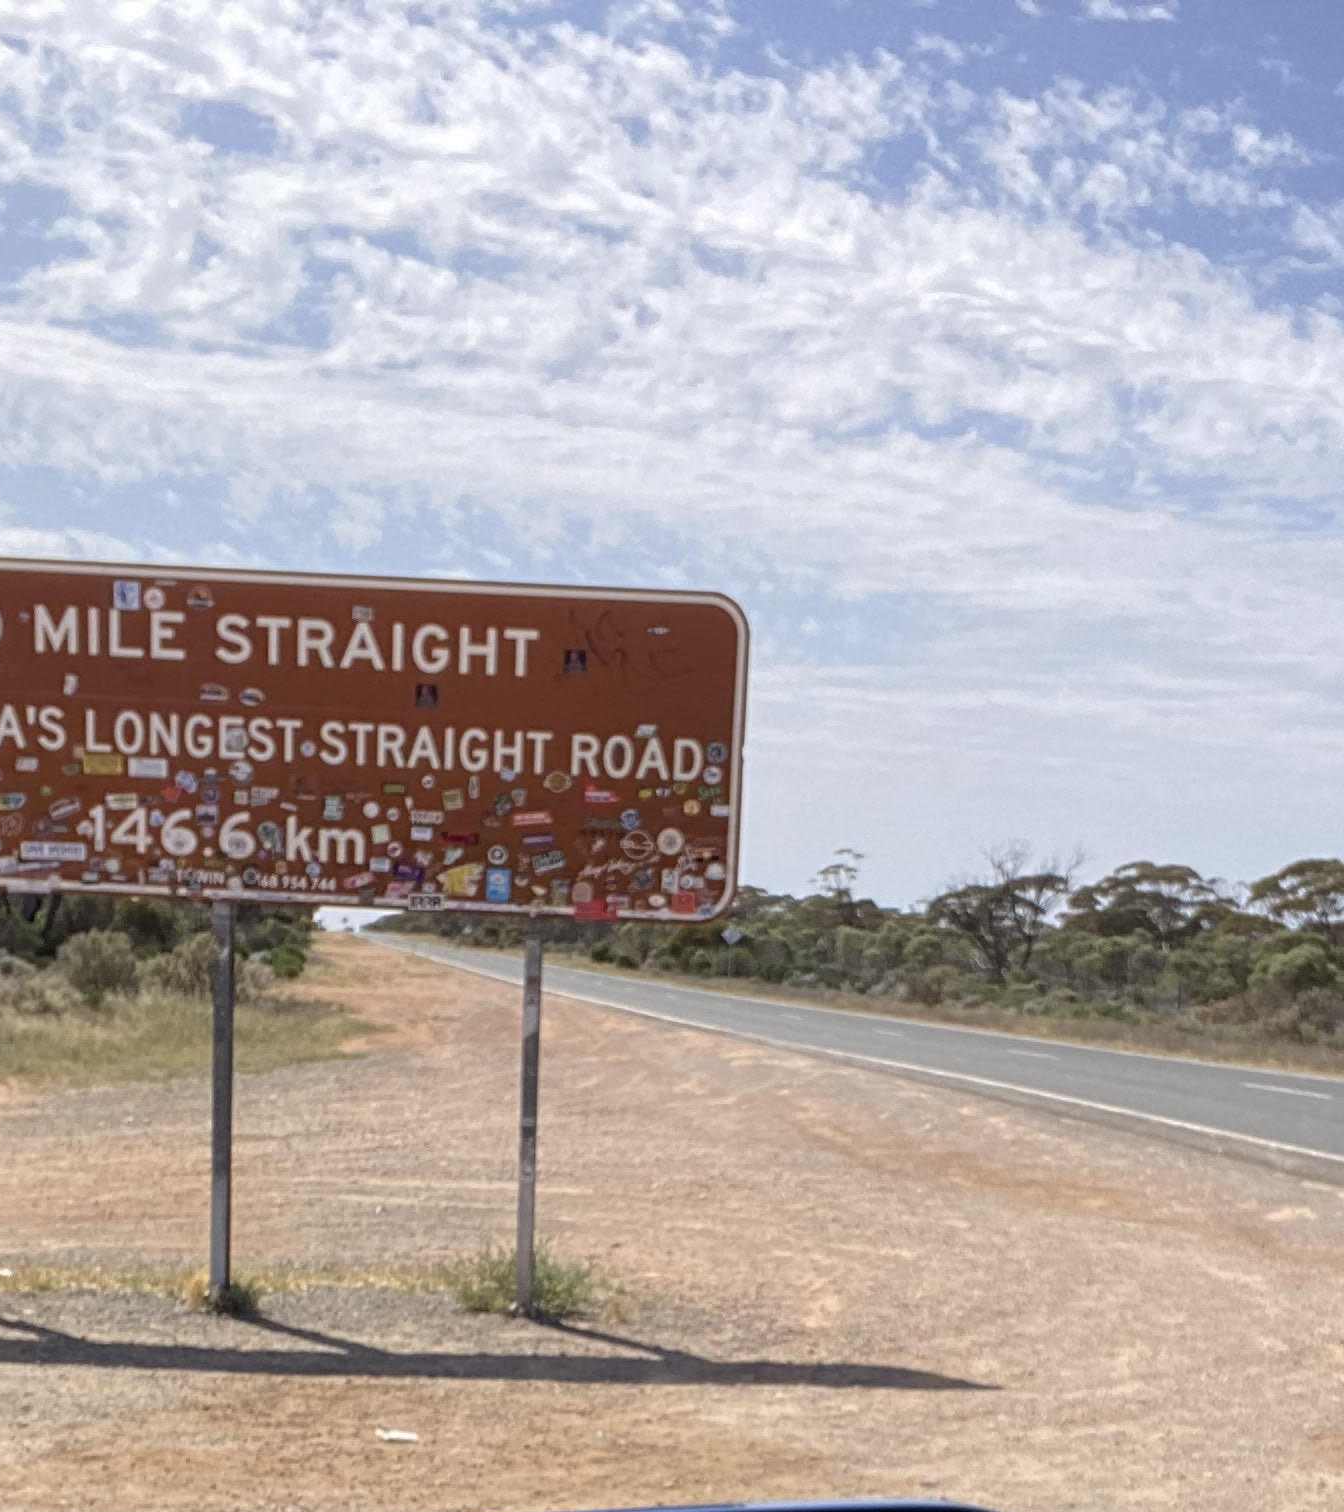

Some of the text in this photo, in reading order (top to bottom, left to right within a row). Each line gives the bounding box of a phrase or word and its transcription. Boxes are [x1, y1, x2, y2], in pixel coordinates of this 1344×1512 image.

[33, 602, 186, 662] MILE
[215, 613, 541, 679] STRAIGHT
[85, 707, 303, 765] LONGEST
[319, 721, 553, 776] STRAIGHT
[570, 732, 704, 782] ROAD
[87, 803, 366, 864] 146.6 km
